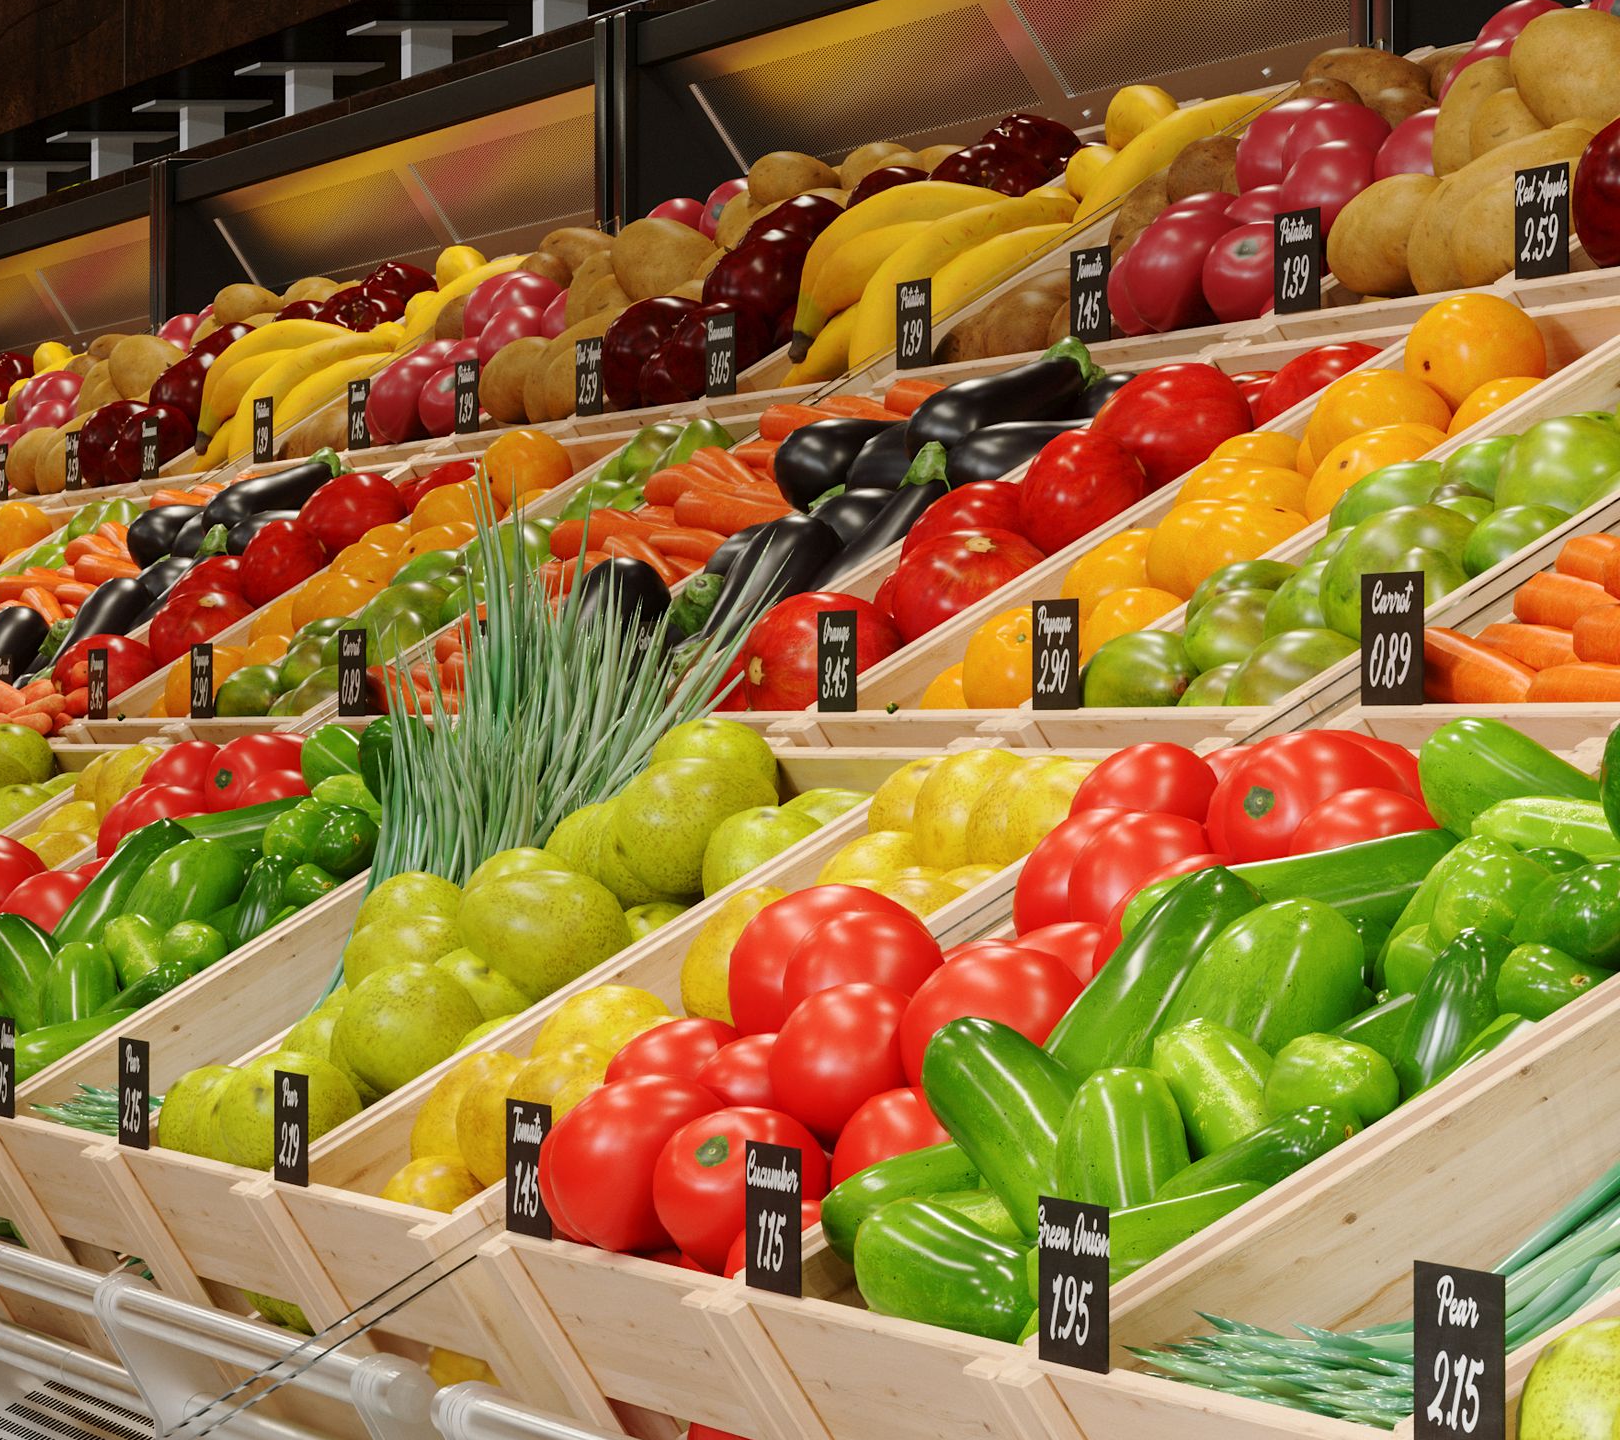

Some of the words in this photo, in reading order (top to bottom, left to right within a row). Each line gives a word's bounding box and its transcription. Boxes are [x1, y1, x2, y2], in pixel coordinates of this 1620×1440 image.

[1515, 175, 1536, 207] Red
[1537, 169, 1568, 212] Apple
[1280, 216, 1312, 246] Potatoes
[1521, 213, 1559, 262] 2.59
[1076, 253, 1103, 282] Tomato
[1282, 254, 1310, 299] 1.39
[900, 286, 925, 311] Potatoes
[1077, 290, 1102, 330] 1.45
[901, 318, 924, 357] 1.39
[457, 364, 475, 387] Potatoes
[709, 350, 731, 386] 3.05
[458, 392, 474, 424] 1.39
[578, 372, 598, 405] 2.59
[256, 426, 269, 454] 1.39
[351, 411, 365, 441] 1.45
[1372, 580, 1414, 614] Carrot
[823, 617, 850, 653] Orange
[1037, 605, 1072, 647] Papaya
[822, 656, 850, 699] 3.45
[1037, 648, 1070, 694] 2.90
[1369, 631, 1412, 689] 0.89
[193, 677, 210, 707] 2.90
[342, 668, 360, 706] 0.89
[125, 1044, 140, 1073] Pear
[122, 1087, 142, 1133] 2.15
[282, 1077, 298, 1108] Pear
[279, 1121, 300, 1168] 2.19
[513, 1106, 543, 1145] Tomato
[513, 1160, 539, 1218] 1.45
[747, 1149, 799, 1194] Cucumber
[757, 1209, 787, 1272] 1.15
[1050, 1274, 1093, 1346] 1.95
[1437, 1275, 1479, 1328] Pear
[1427, 1350, 1484, 1433] 2.15
